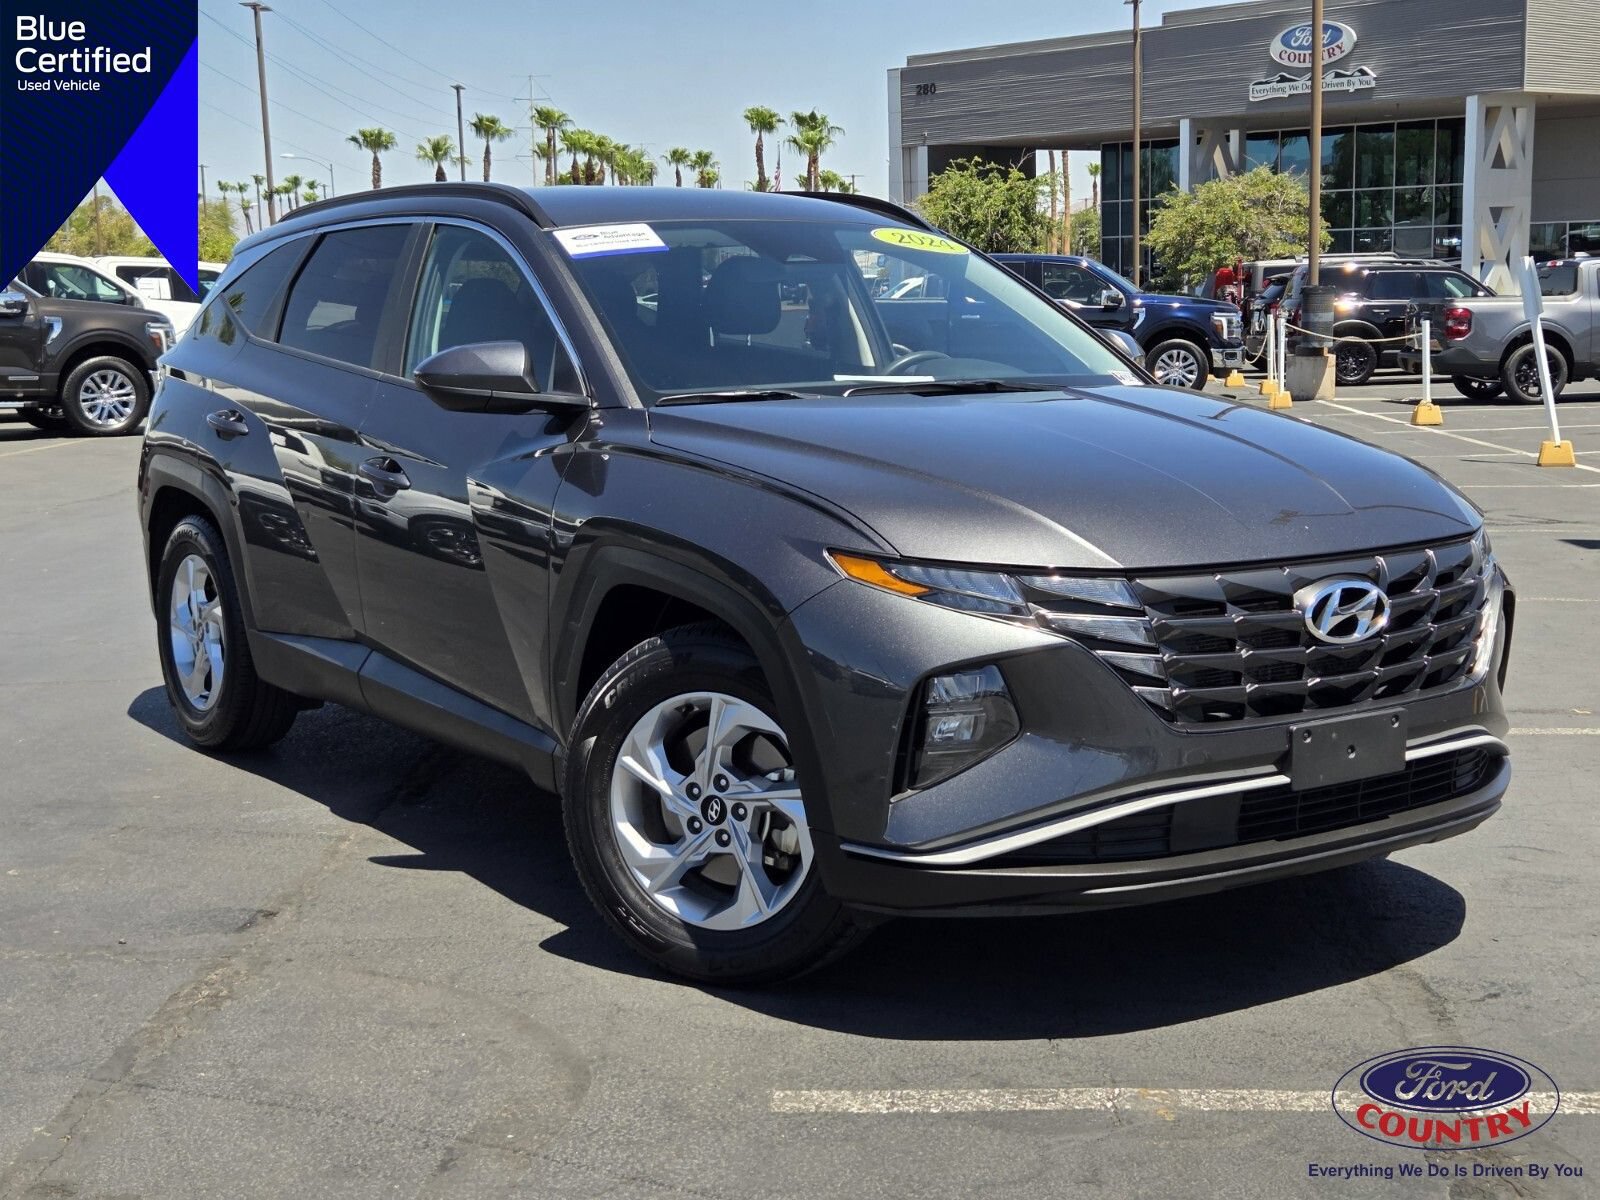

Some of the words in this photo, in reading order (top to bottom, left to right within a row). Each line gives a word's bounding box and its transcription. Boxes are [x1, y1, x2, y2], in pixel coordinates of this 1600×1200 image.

[1290, 27, 1331, 47] Fod
[915, 83, 937, 96] 280
[1251, 83, 1287, 96] Everything
[1288, 84, 1300, 92] We
[1321, 80, 1345, 89] Driven
[1347, 79, 1356, 88] By
[1358, 78, 1371, 86] You
